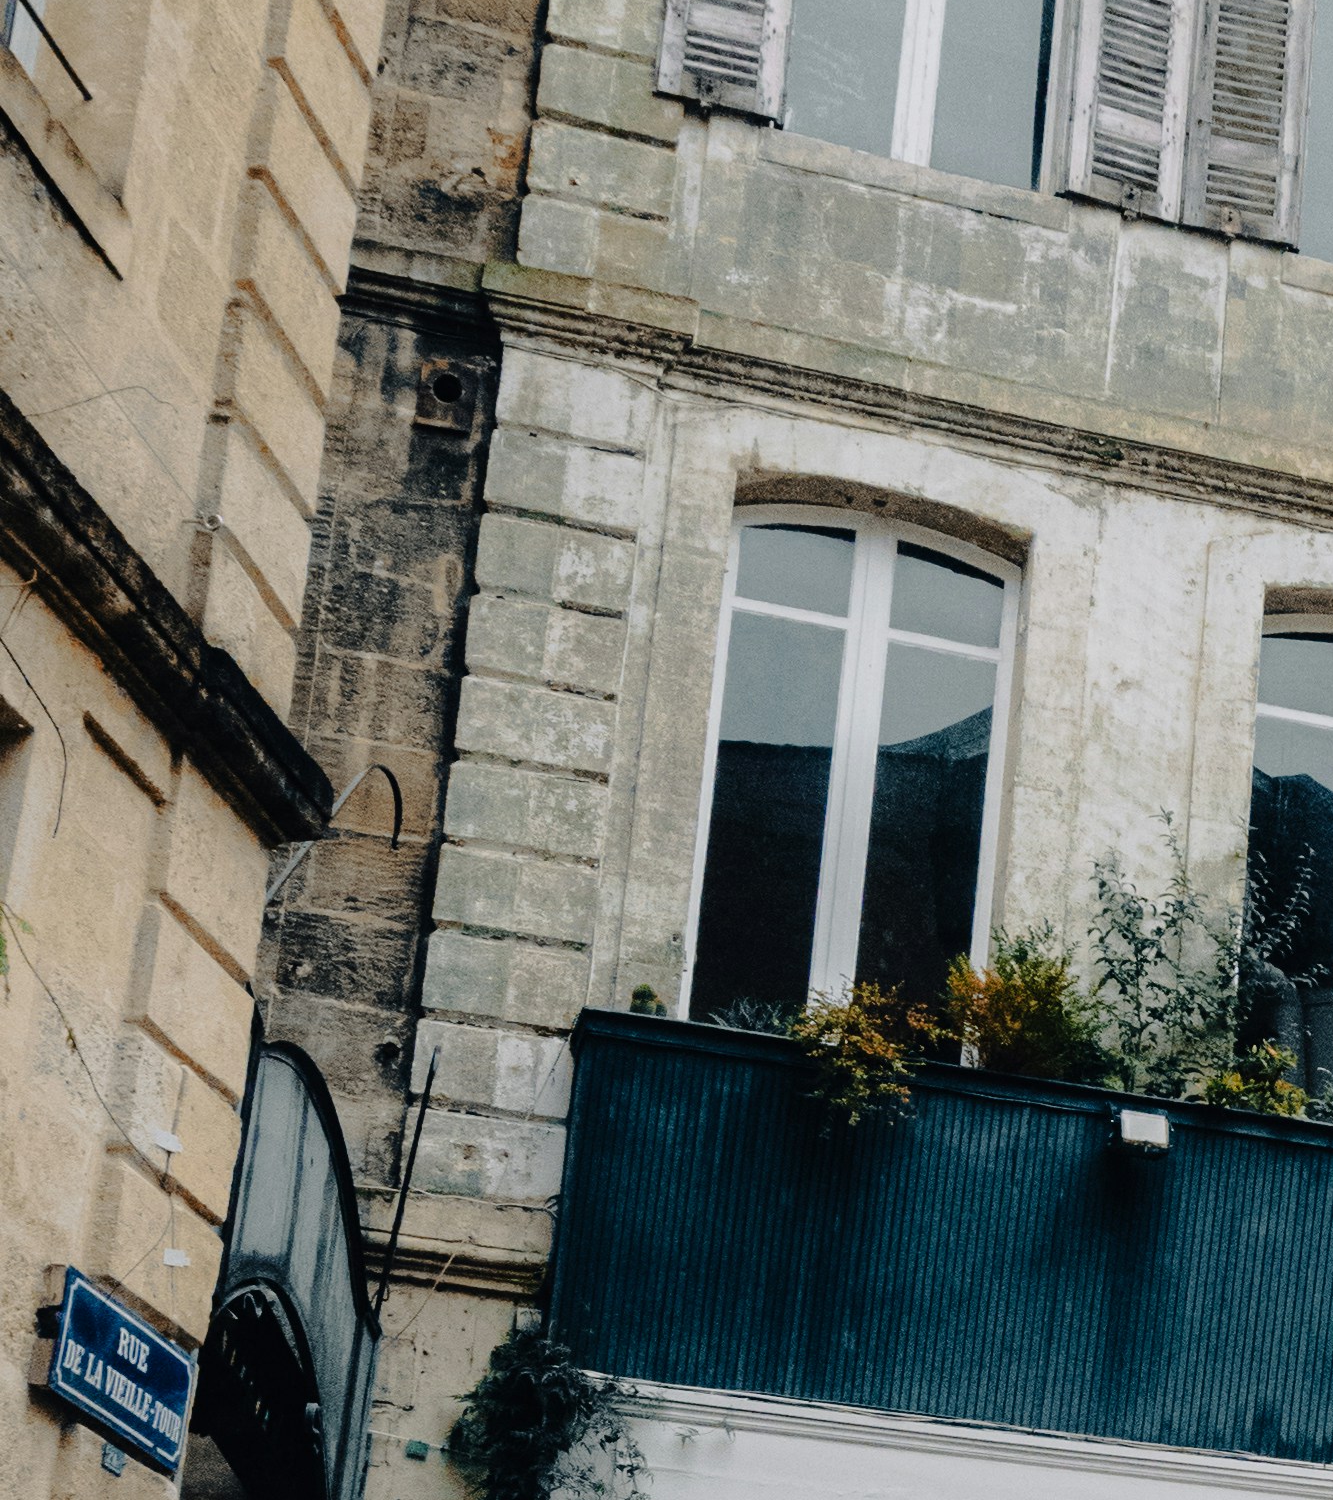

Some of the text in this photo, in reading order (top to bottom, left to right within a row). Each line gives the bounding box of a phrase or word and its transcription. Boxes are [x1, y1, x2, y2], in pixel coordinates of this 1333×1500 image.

[116, 1326, 150, 1374] RUE
[62, 1338, 182, 1445] DE LA VIEILLE-TOUR
